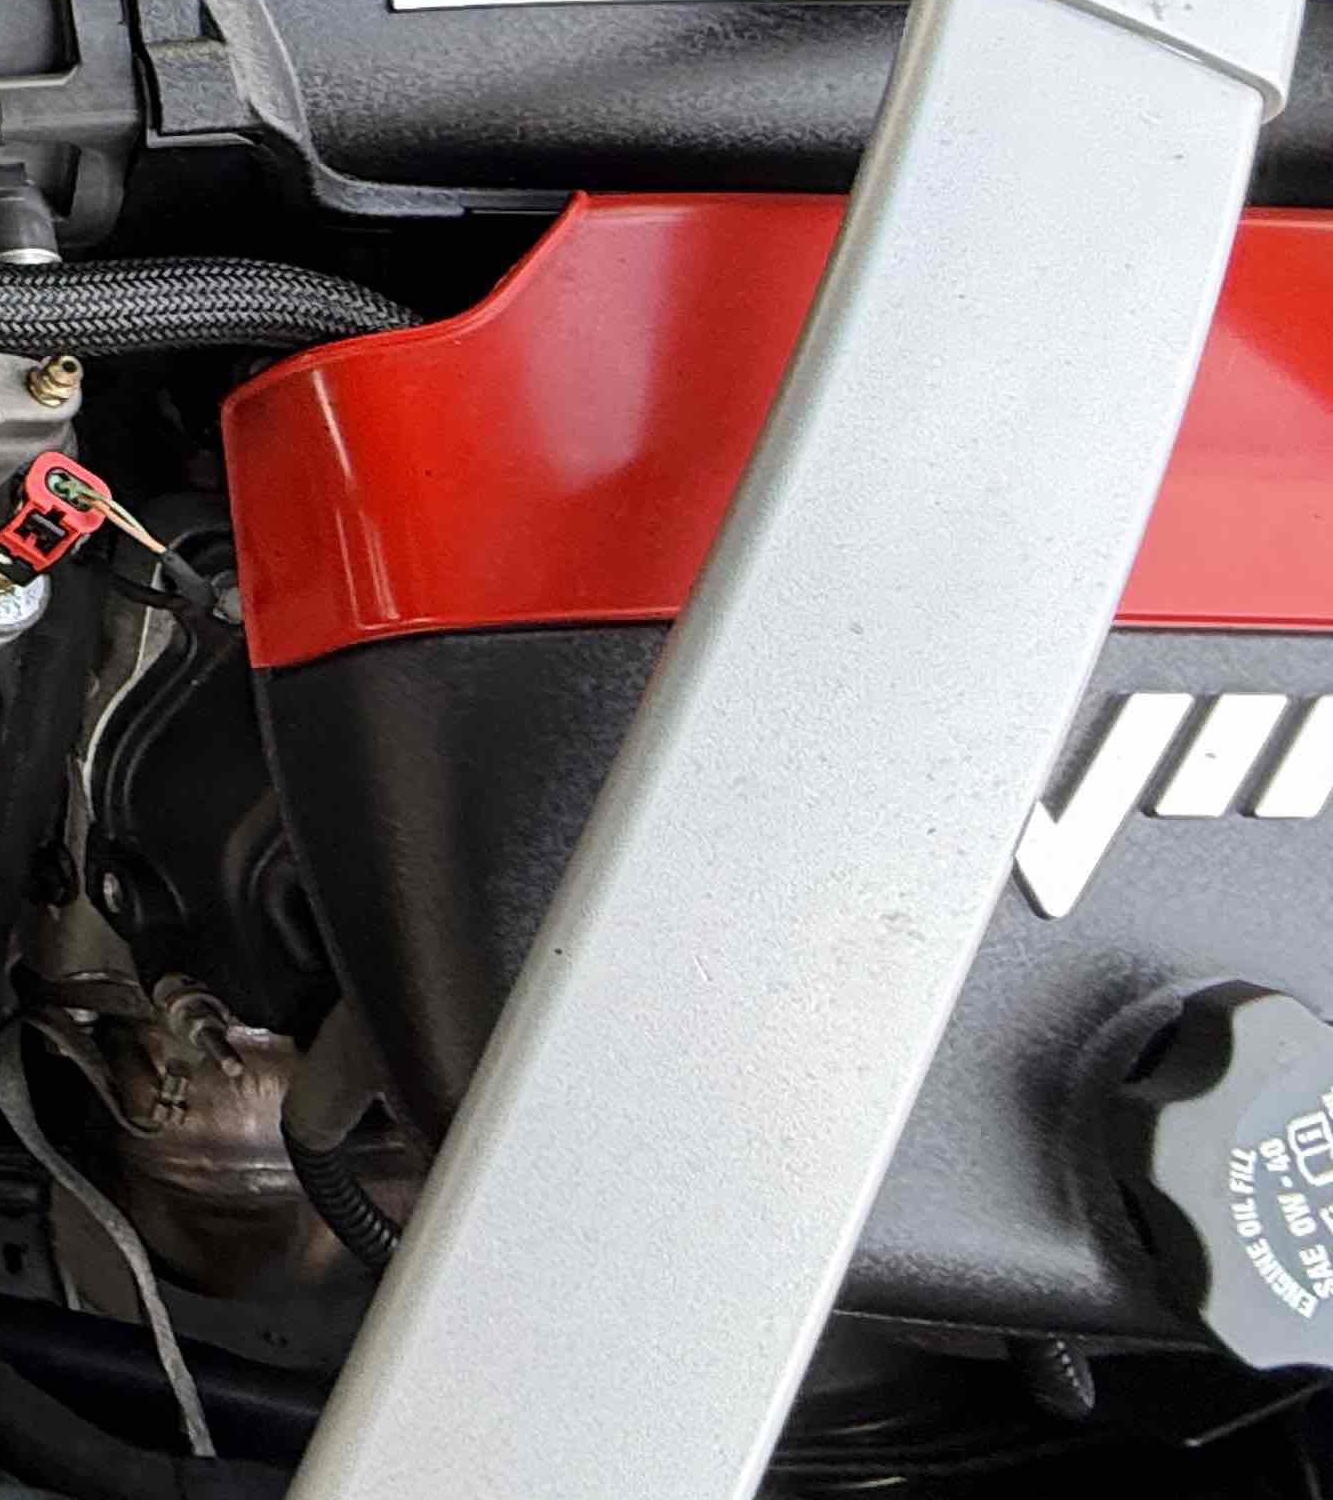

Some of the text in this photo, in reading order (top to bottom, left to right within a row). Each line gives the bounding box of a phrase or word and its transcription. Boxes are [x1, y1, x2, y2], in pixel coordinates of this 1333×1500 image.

[1229, 1147, 1318, 1319] ENGINE OIL FILL
[1299, 1244, 1333, 1299] SAE
